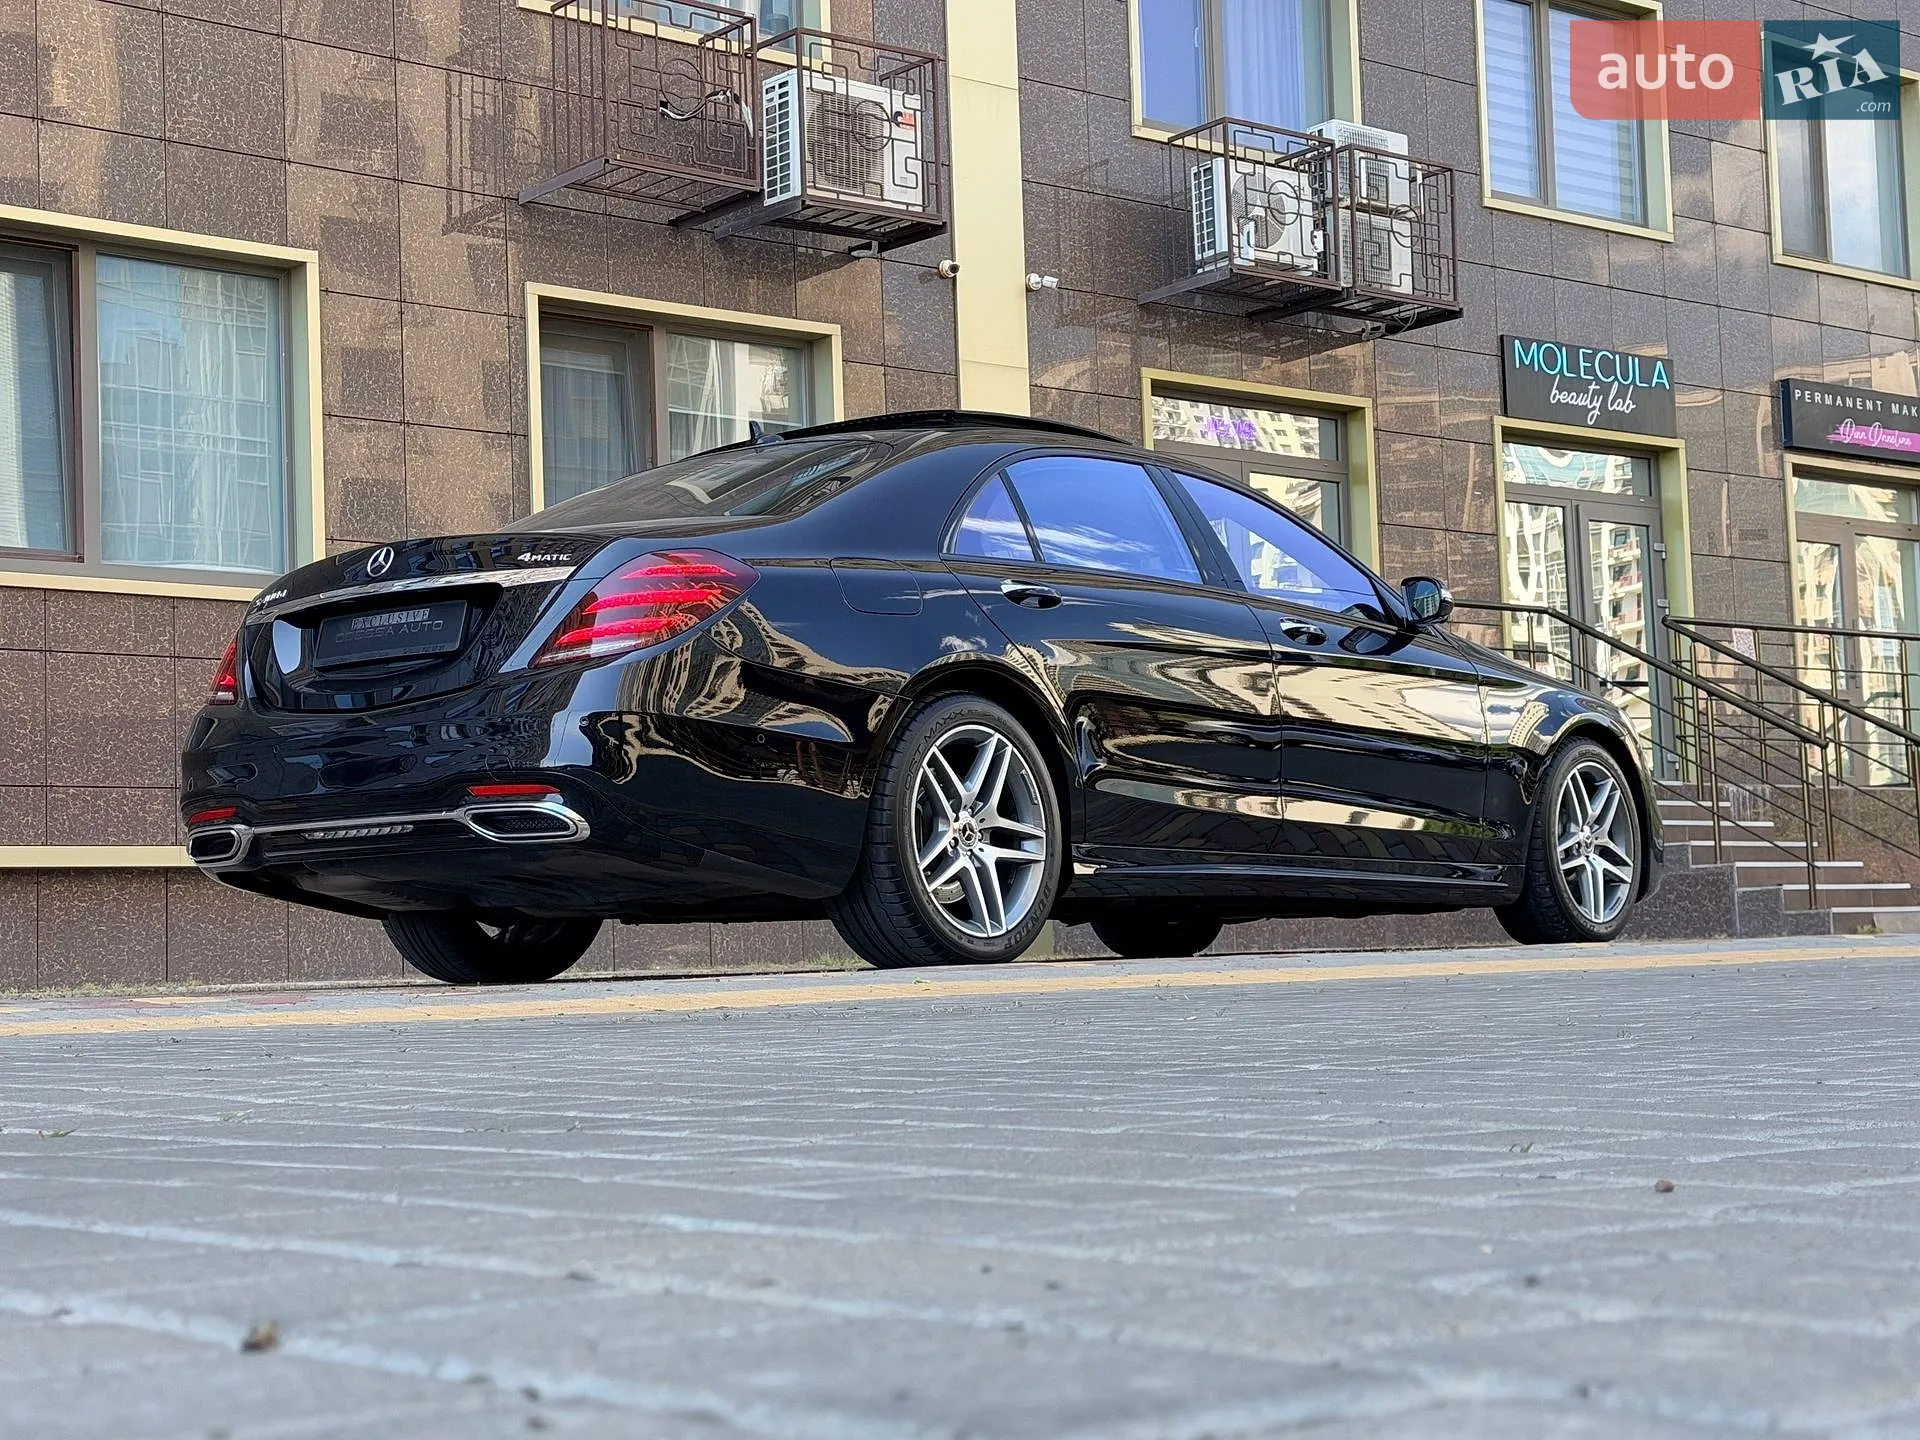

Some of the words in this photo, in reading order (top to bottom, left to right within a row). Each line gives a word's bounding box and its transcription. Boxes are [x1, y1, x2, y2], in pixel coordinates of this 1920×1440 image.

[1514, 339, 1670, 390] MOLECULA
[1550, 374, 1604, 426] beauty
[1608, 380, 1637, 415] lab
[1794, 389, 1883, 412] PERMANENT
[517, 552, 572, 562] 4MATIC
[351, 608, 430, 630] EXCLUSIVE
[335, 626, 394, 643] ODESSA
[399, 620, 444, 635] AUTO
